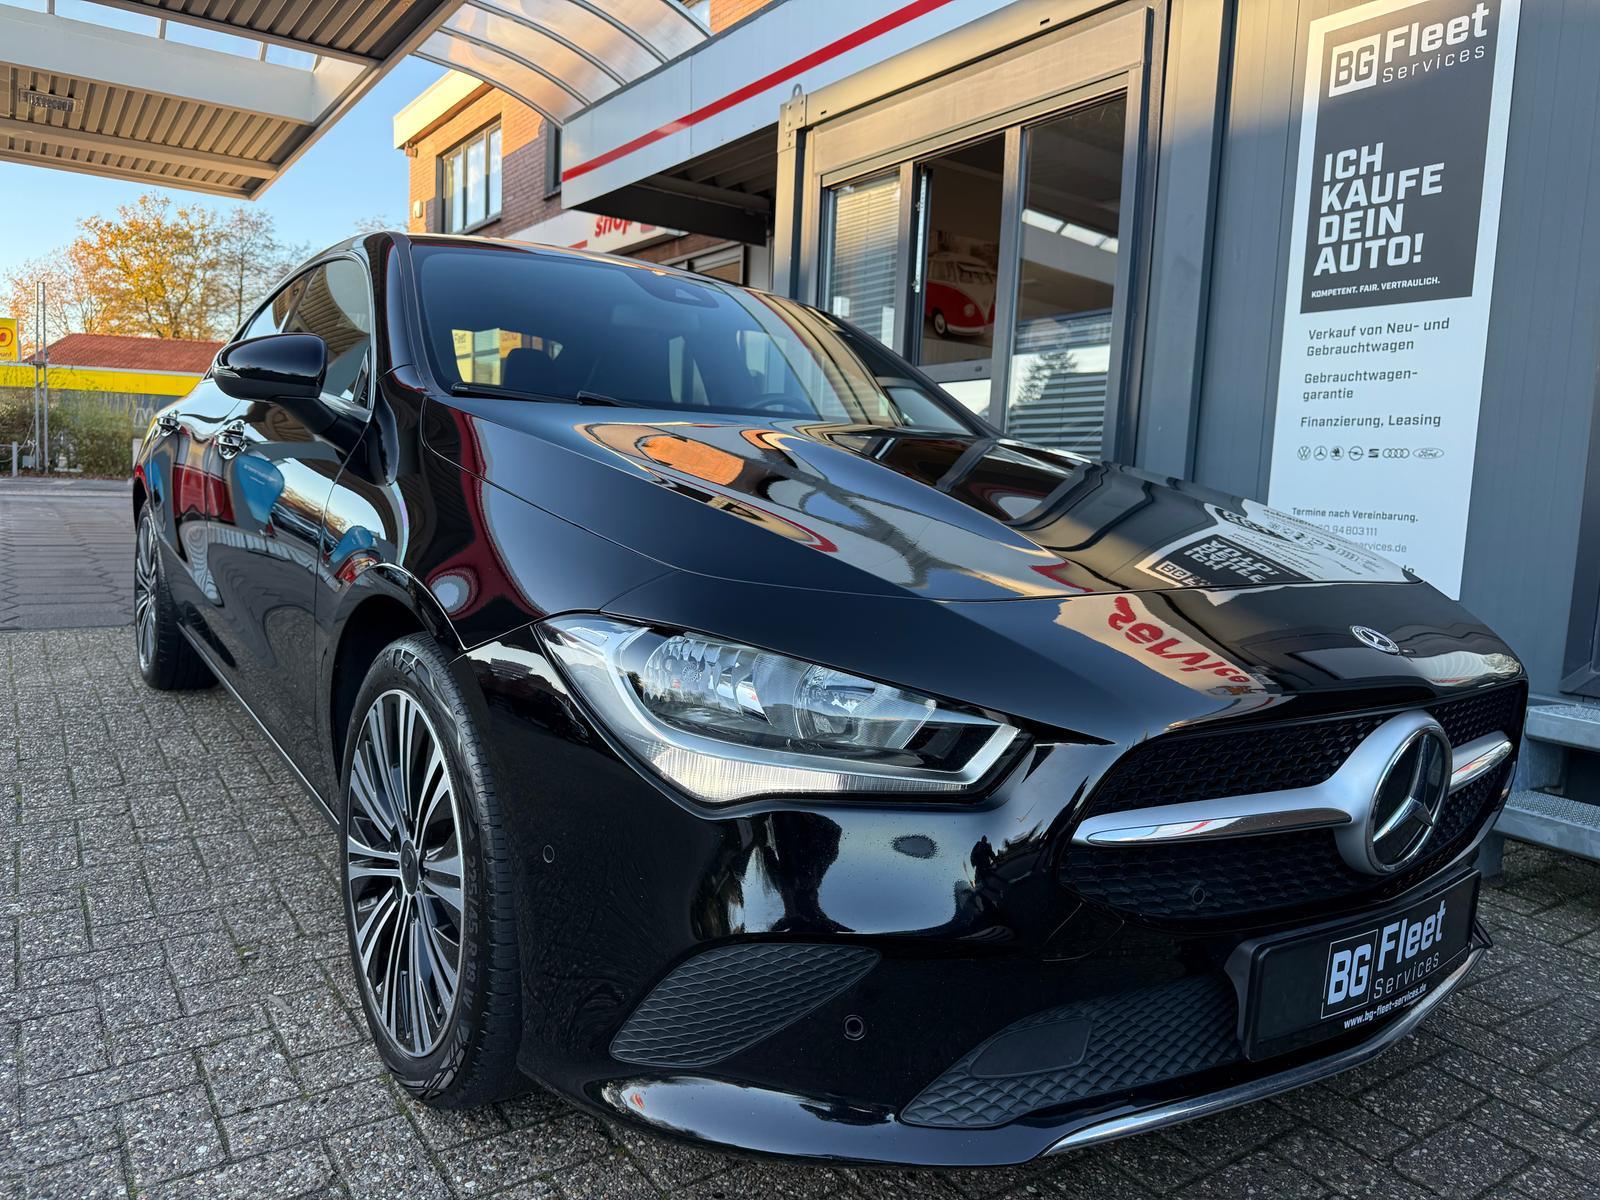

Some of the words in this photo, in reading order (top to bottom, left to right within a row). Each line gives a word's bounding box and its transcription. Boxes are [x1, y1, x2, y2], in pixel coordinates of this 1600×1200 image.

[1333, 45, 1376, 88] BG
[1384, 3, 1488, 63] Fleet
[1382, 45, 1485, 84] Services
[1323, 142, 1384, 182] ICH
[1320, 162, 1445, 213] KAUFE
[1317, 203, 1404, 245] DEIN
[1313, 233, 1424, 276] AUTO!
[1311, 285, 1358, 298] KOMPETENT.
[1359, 282, 1380, 293] FAIR.
[1381, 277, 1441, 290] VERTRAULICH.
[1307, 340, 1414, 356] Gebrauchtwagen
[1308, 325, 1356, 340] Verkauf
[1359, 324, 1383, 336] von
[1386, 321, 1419, 334] Neu-
[1423, 317, 1450, 331] und
[1303, 387, 1354, 402] garantie
[1304, 370, 1418, 384] Gebrauchtwagen-
[1300, 416, 1384, 428] Finanzierung,
[1388, 414, 1441, 428] Leasing
[1292, 507, 1326, 518] Termine
[1328, 510, 1350, 519] nach
[1352, 510, 1419, 523] Vereinbarung.
[1327, 943, 1372, 1005] BG
[1377, 900, 1446, 972] Fleet
[1373, 952, 1440, 999] Services
[1343, 983, 1427, 1030] www.bg-fleet-services.de
